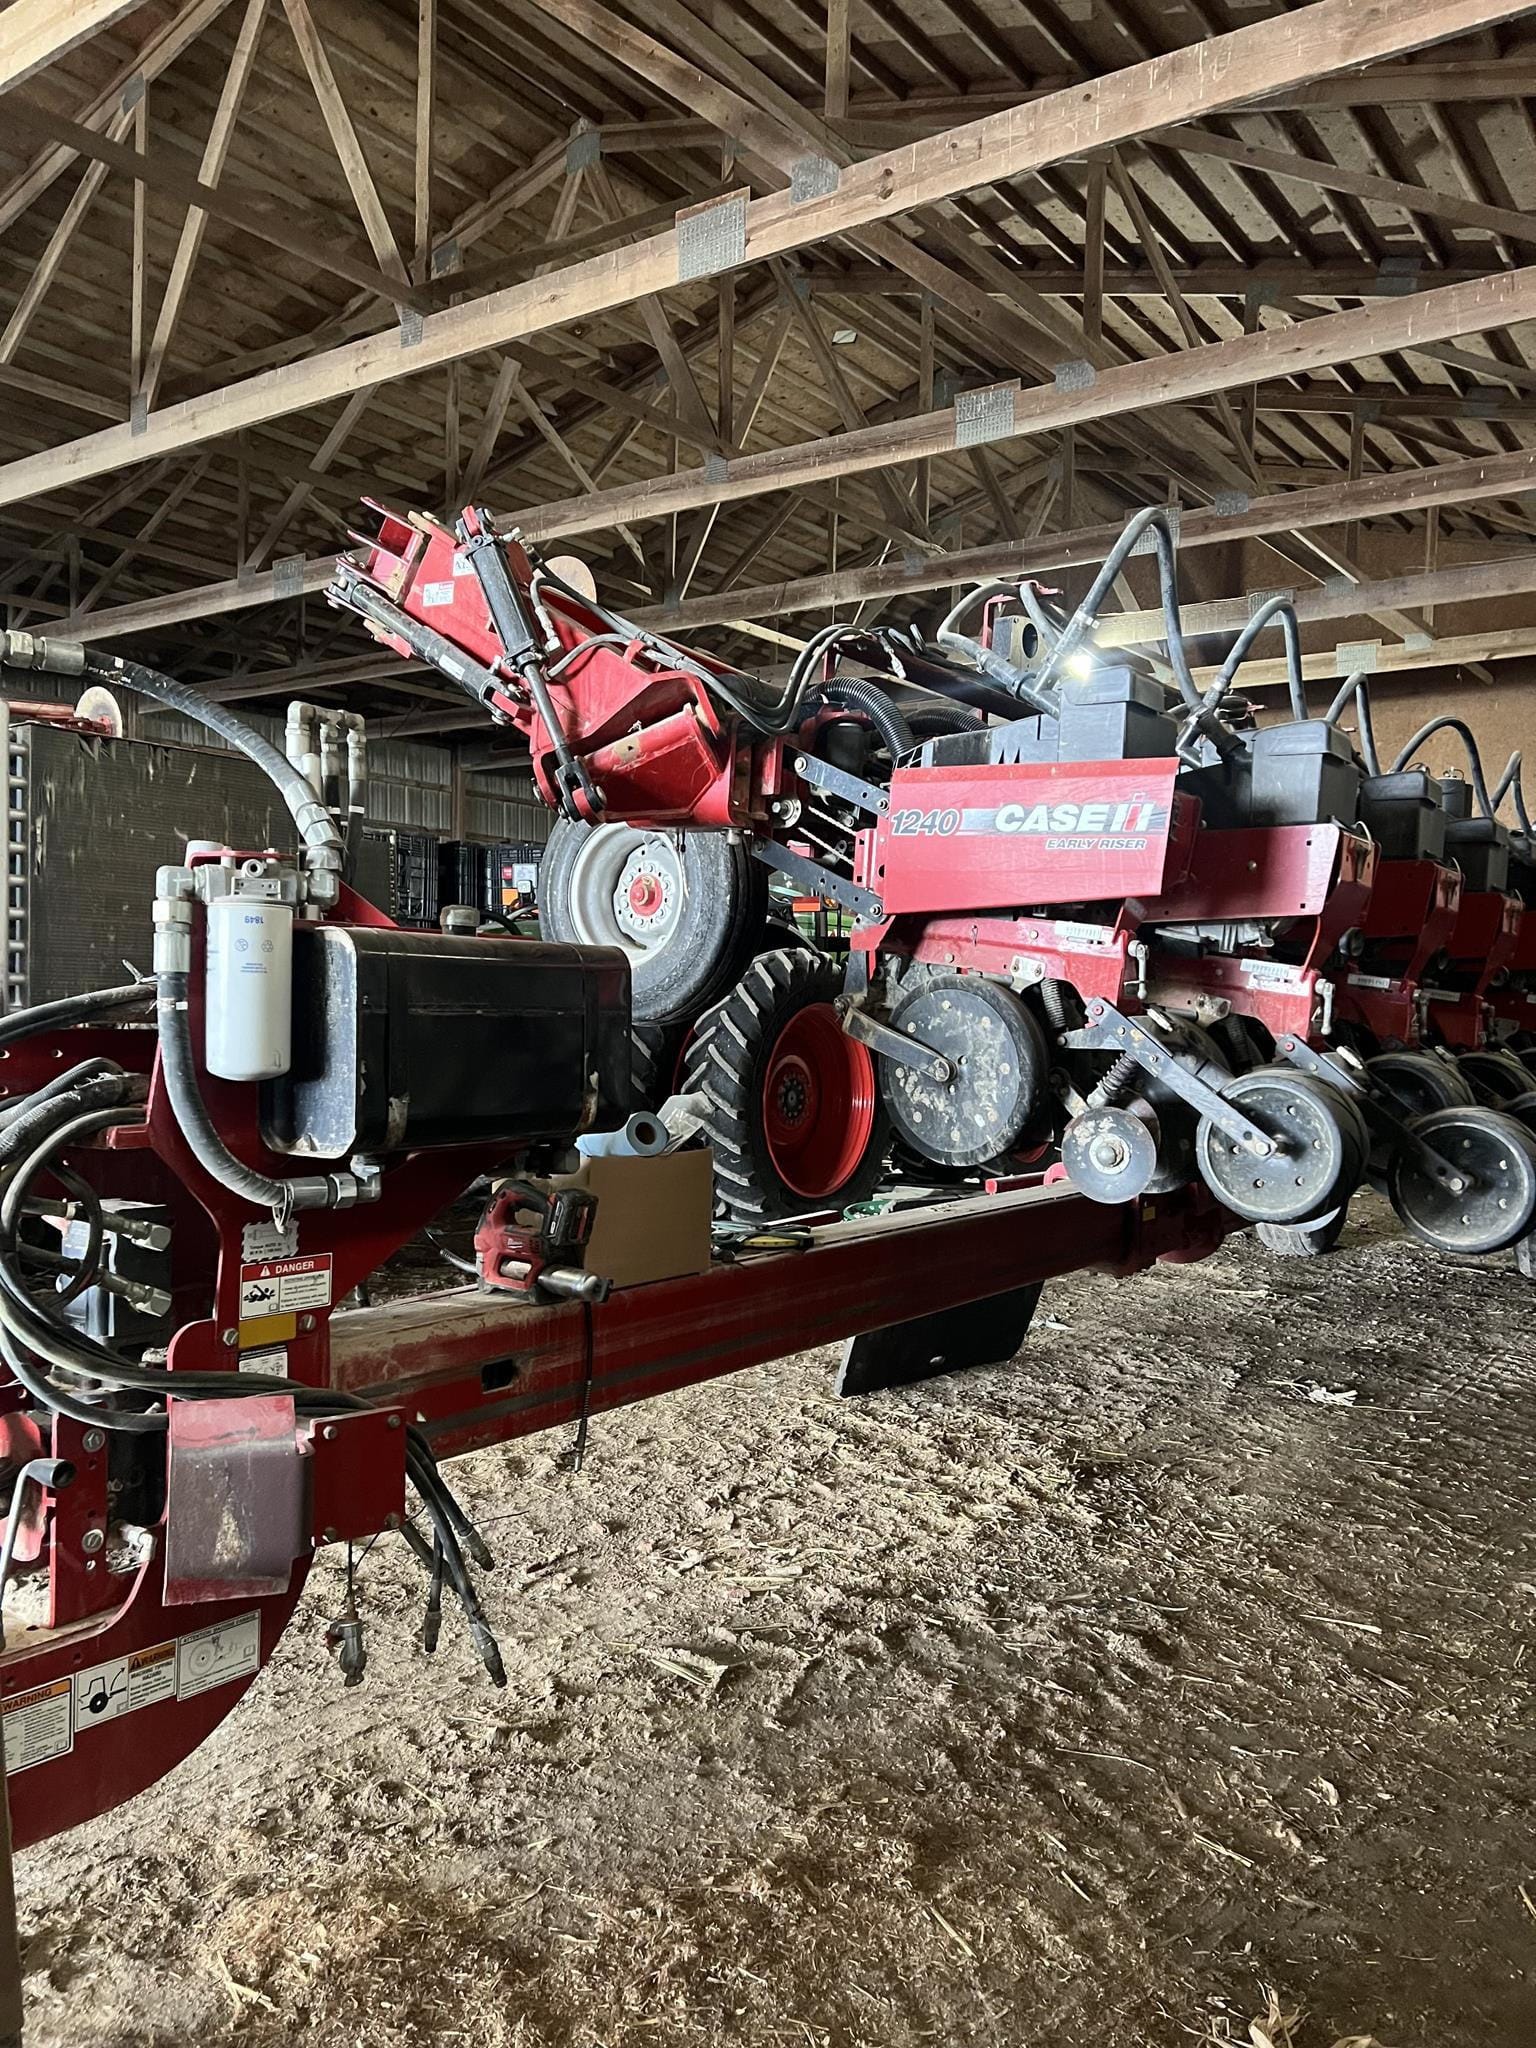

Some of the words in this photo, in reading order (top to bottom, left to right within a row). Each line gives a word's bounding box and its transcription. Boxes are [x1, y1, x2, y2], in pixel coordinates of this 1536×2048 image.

[891, 808, 960, 836] 1240
[1046, 838, 1095, 850] EARLY
[1097, 838, 1147, 850] RISER
[244, 915, 264, 924] 1849
[275, 1260, 315, 1274] DANGER
[2, 1688, 52, 1711] WARNING
